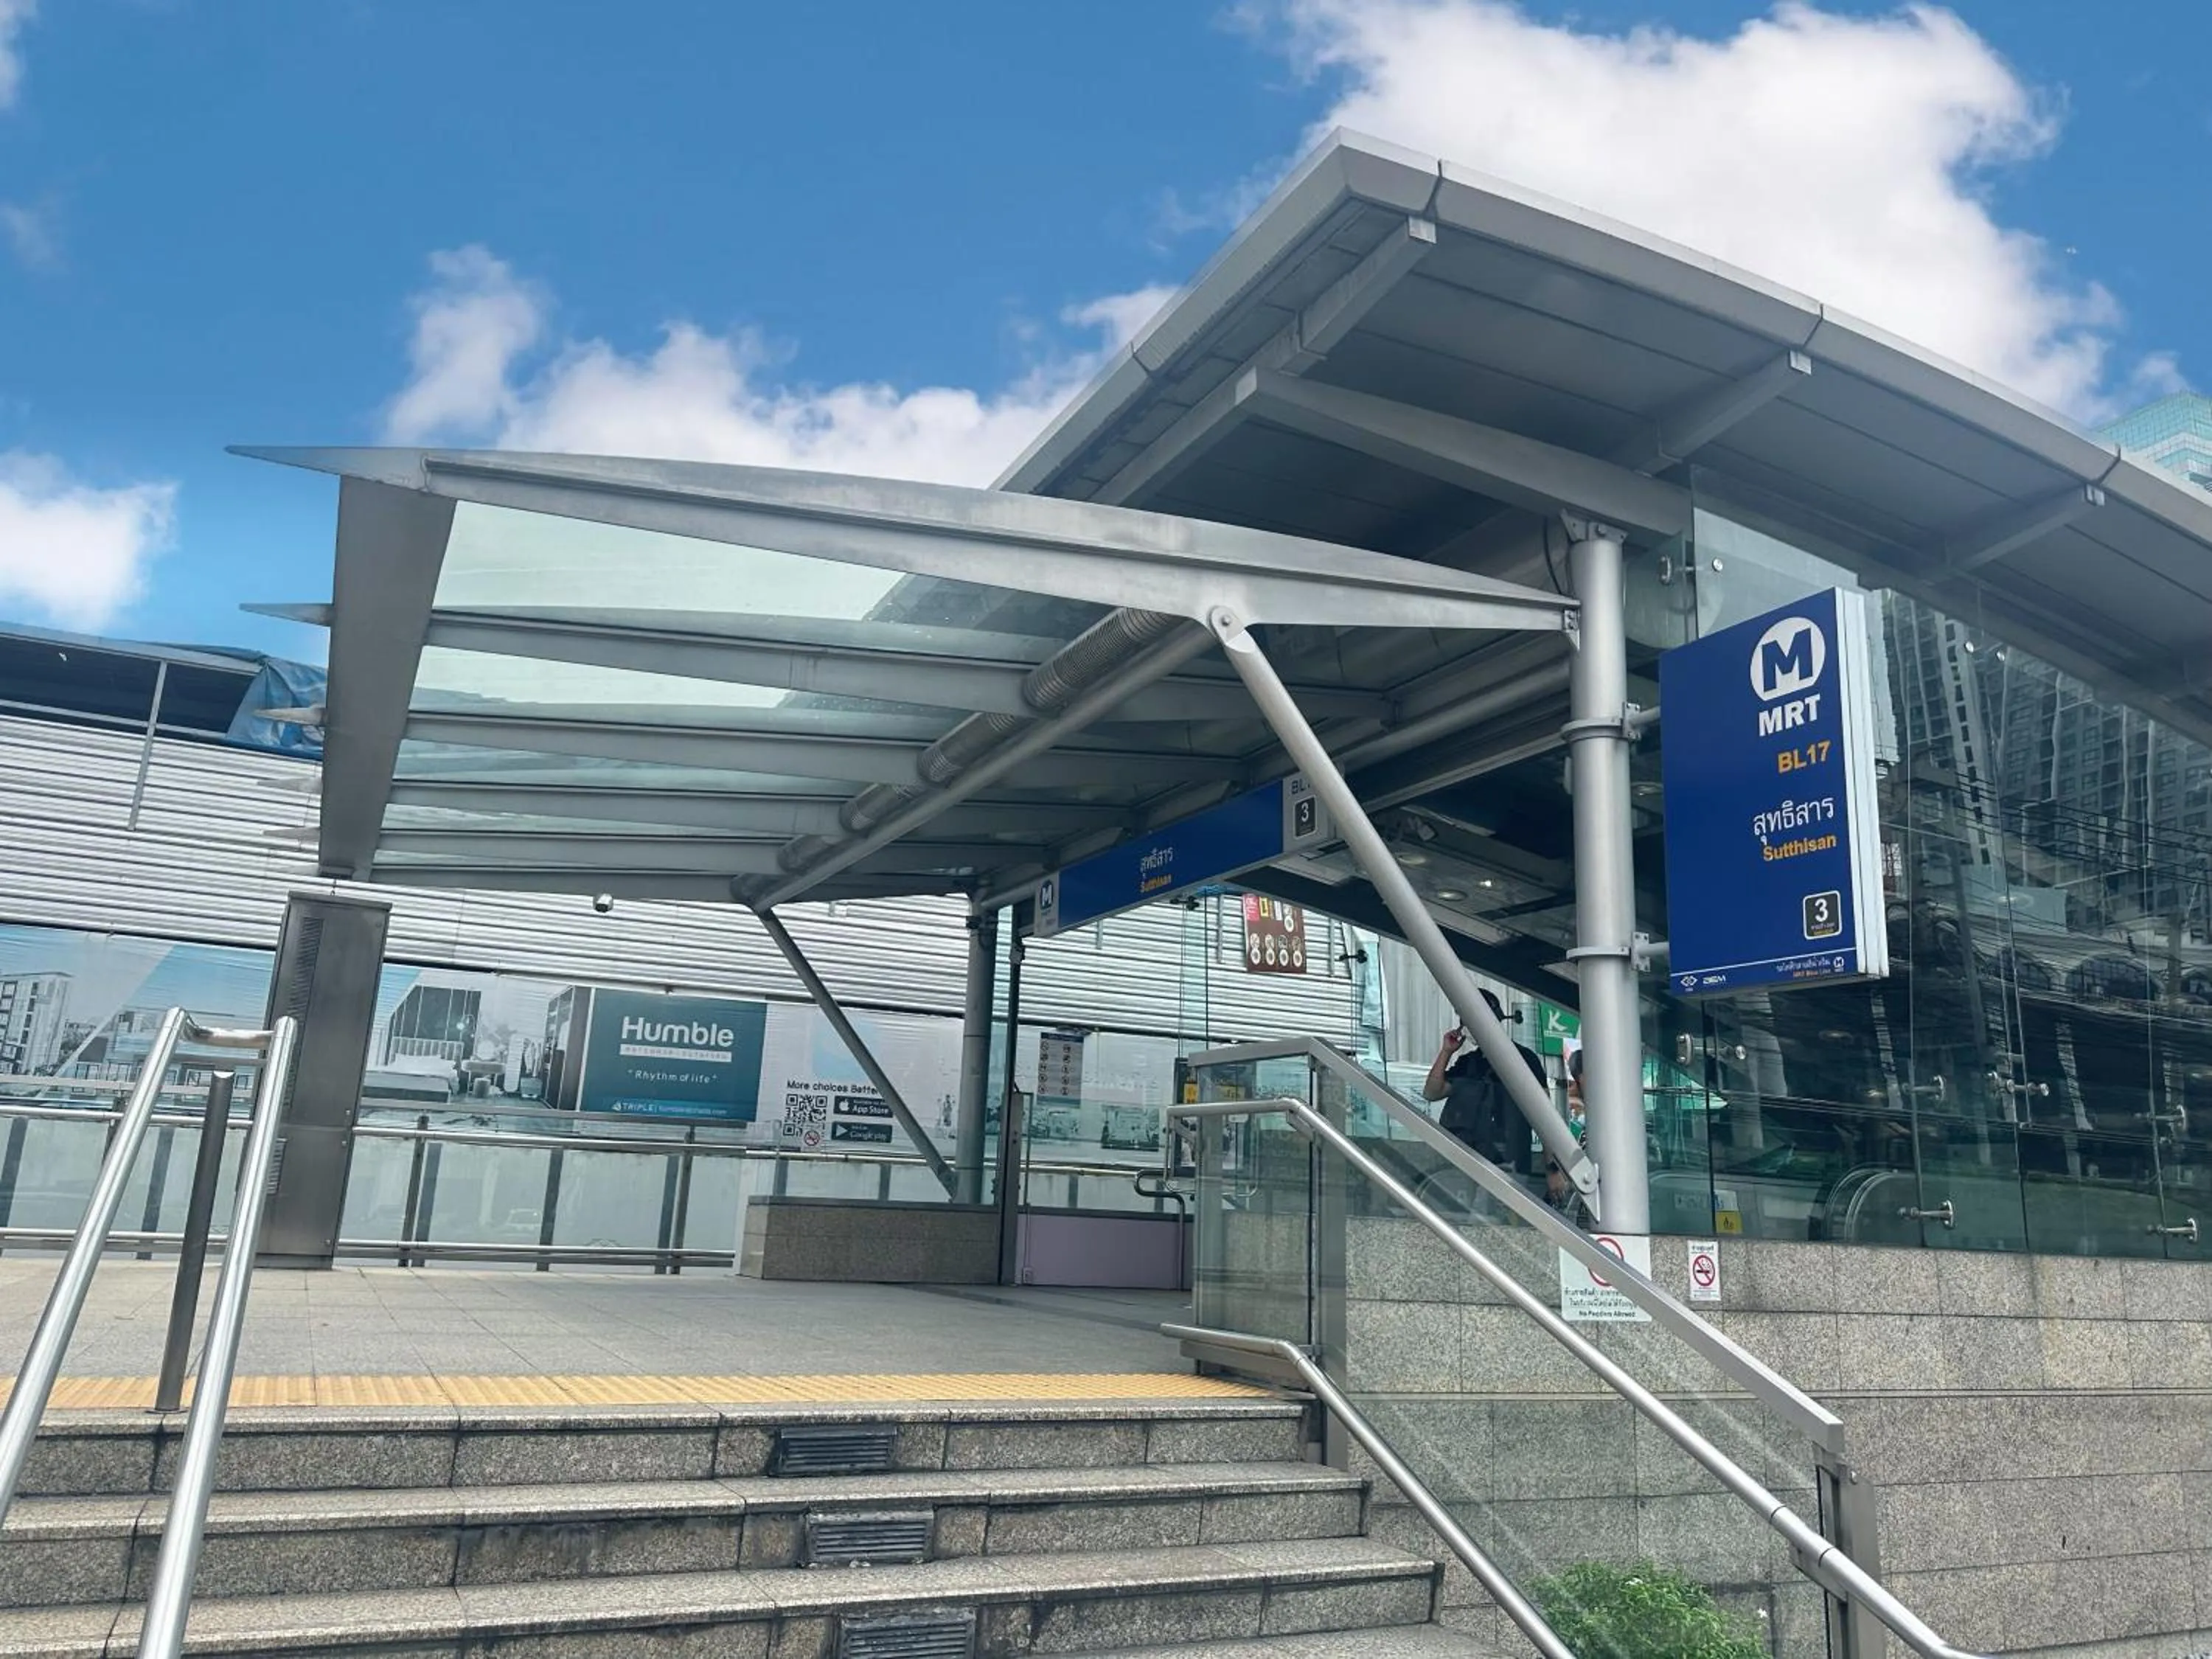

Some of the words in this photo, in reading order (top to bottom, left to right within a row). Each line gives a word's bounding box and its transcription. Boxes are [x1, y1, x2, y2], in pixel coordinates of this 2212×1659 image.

[1759, 693, 1820, 737] MRT
[1777, 740, 1831, 773] BL17
[1301, 801, 1309, 822] 3
[1753, 797, 1834, 846] สุทธิสาร
[1763, 835, 1837, 862] Sutthisan
[1815, 898, 1829, 922] 3
[622, 1016, 734, 1047] Humble
[787, 1079, 810, 1090] More
[813, 1081, 848, 1092] choices
[852, 1105, 868, 1114] App
